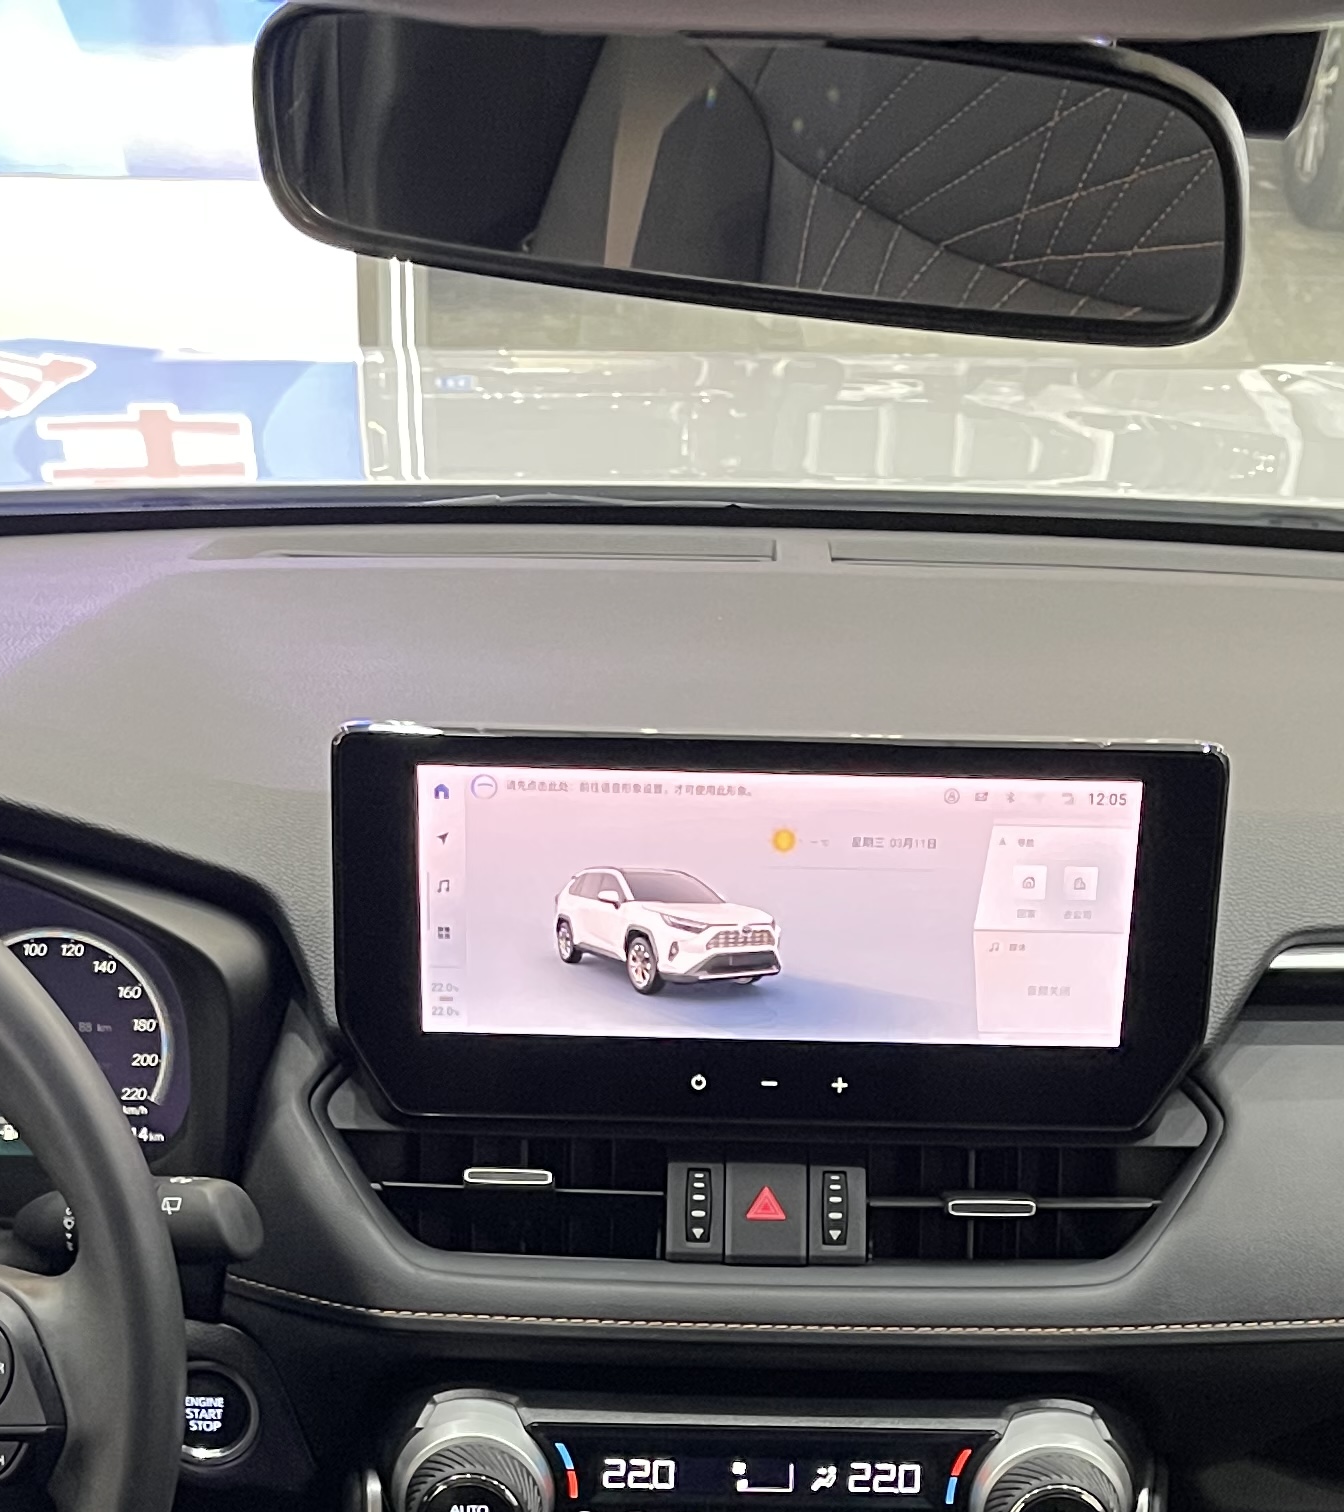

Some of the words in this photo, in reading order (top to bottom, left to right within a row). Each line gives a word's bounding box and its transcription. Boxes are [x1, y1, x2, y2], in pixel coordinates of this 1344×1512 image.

[1089, 792, 1127, 806] 12:05
[852, 836, 885, 848] 星期三
[23, 943, 48, 957] 100
[61, 943, 85, 957] 120
[93, 961, 117, 974] 140
[117, 985, 142, 999] 160
[132, 1019, 157, 1032] 180
[131, 1053, 159, 1067] 200
[121, 1087, 148, 1101] 220
[122, 1105, 148, 1116] km/h
[185, 1396, 225, 1408] ENGINE
[185, 1408, 223, 1420] START
[189, 1420, 222, 1432] STOP
